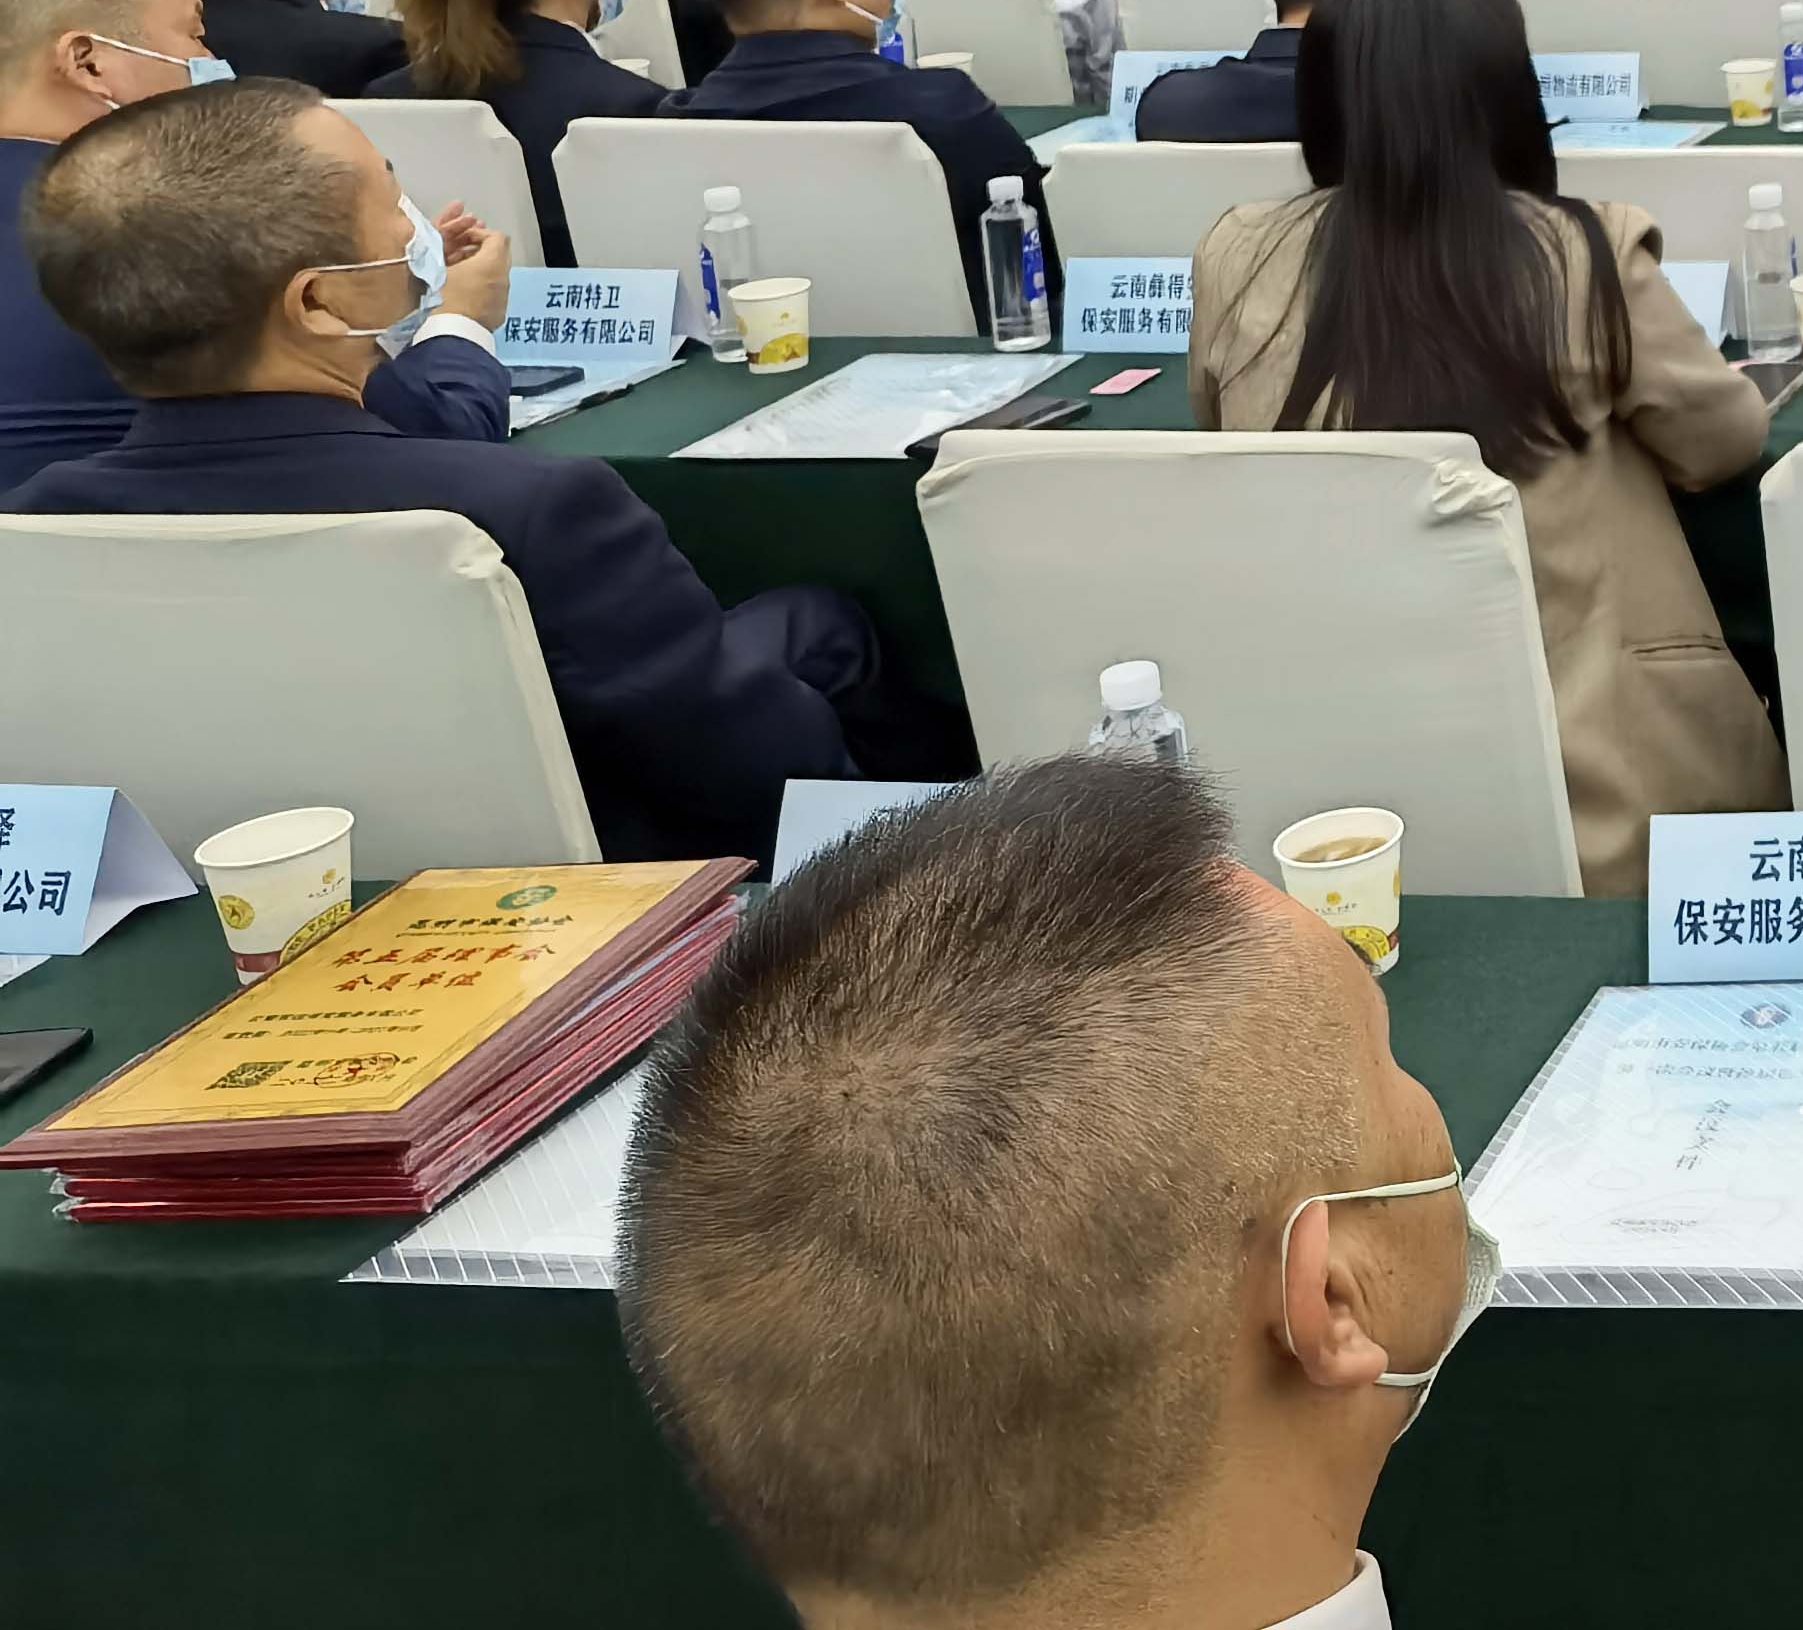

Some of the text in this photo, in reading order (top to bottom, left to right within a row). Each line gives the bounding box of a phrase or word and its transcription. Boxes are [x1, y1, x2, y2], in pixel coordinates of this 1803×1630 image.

[546, 282, 621, 310] 云南特卫
[504, 316, 655, 346] 保安服务有限公司
